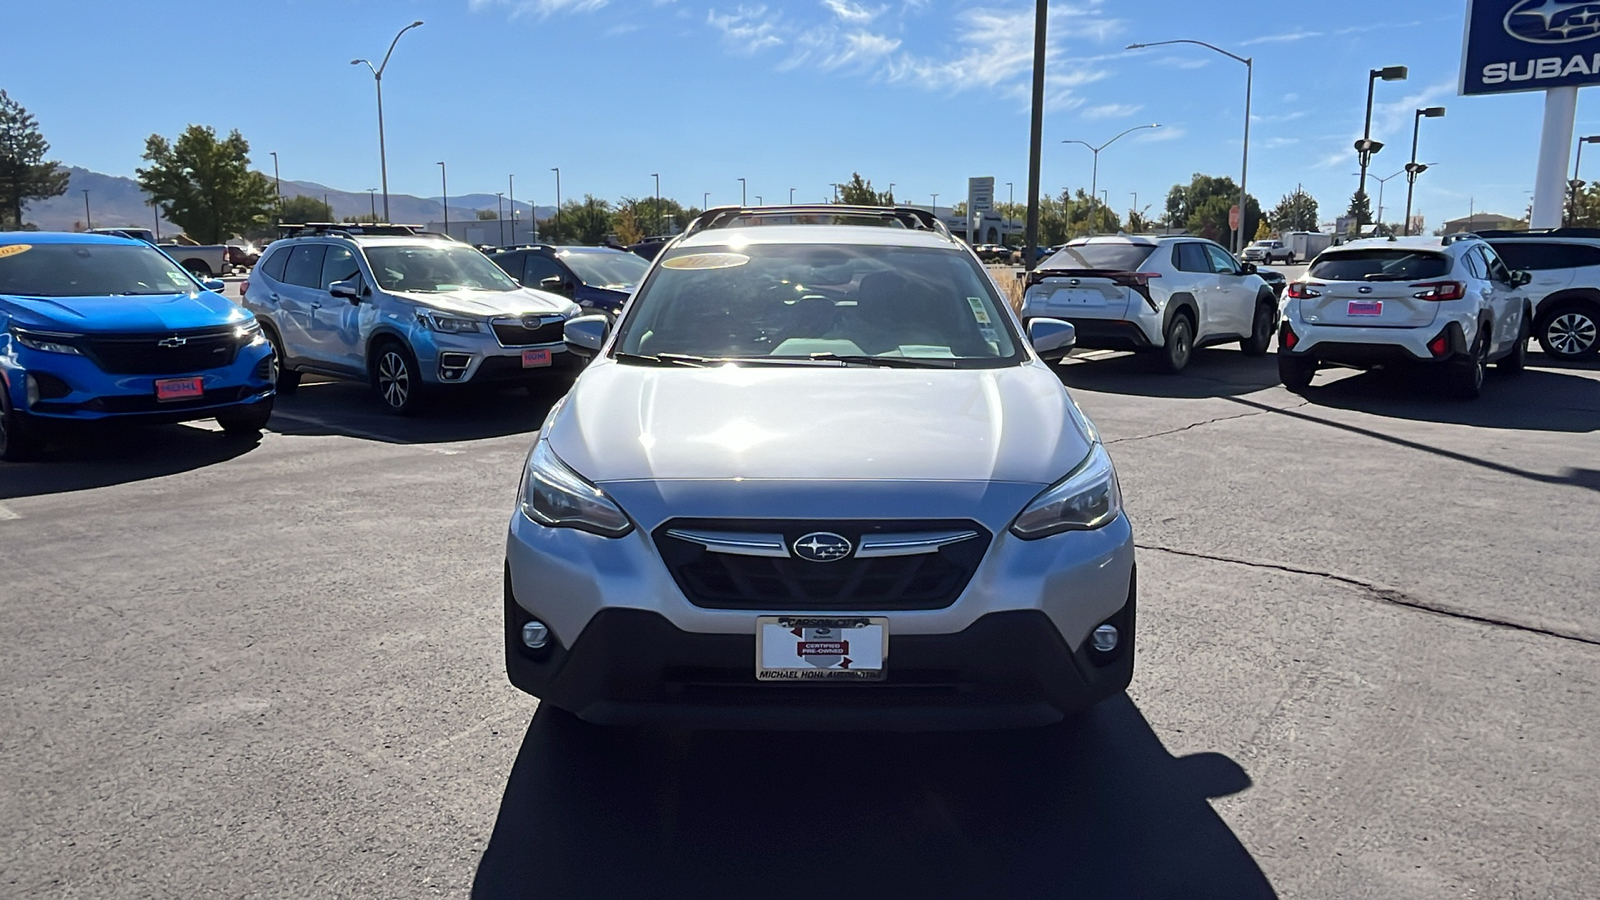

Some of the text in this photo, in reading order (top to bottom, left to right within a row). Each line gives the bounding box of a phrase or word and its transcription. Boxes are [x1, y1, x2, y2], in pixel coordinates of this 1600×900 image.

[1482, 53, 1600, 84] SUBA
[759, 670, 799, 679] MICHAEL
[800, 670, 825, 679] HOHL
